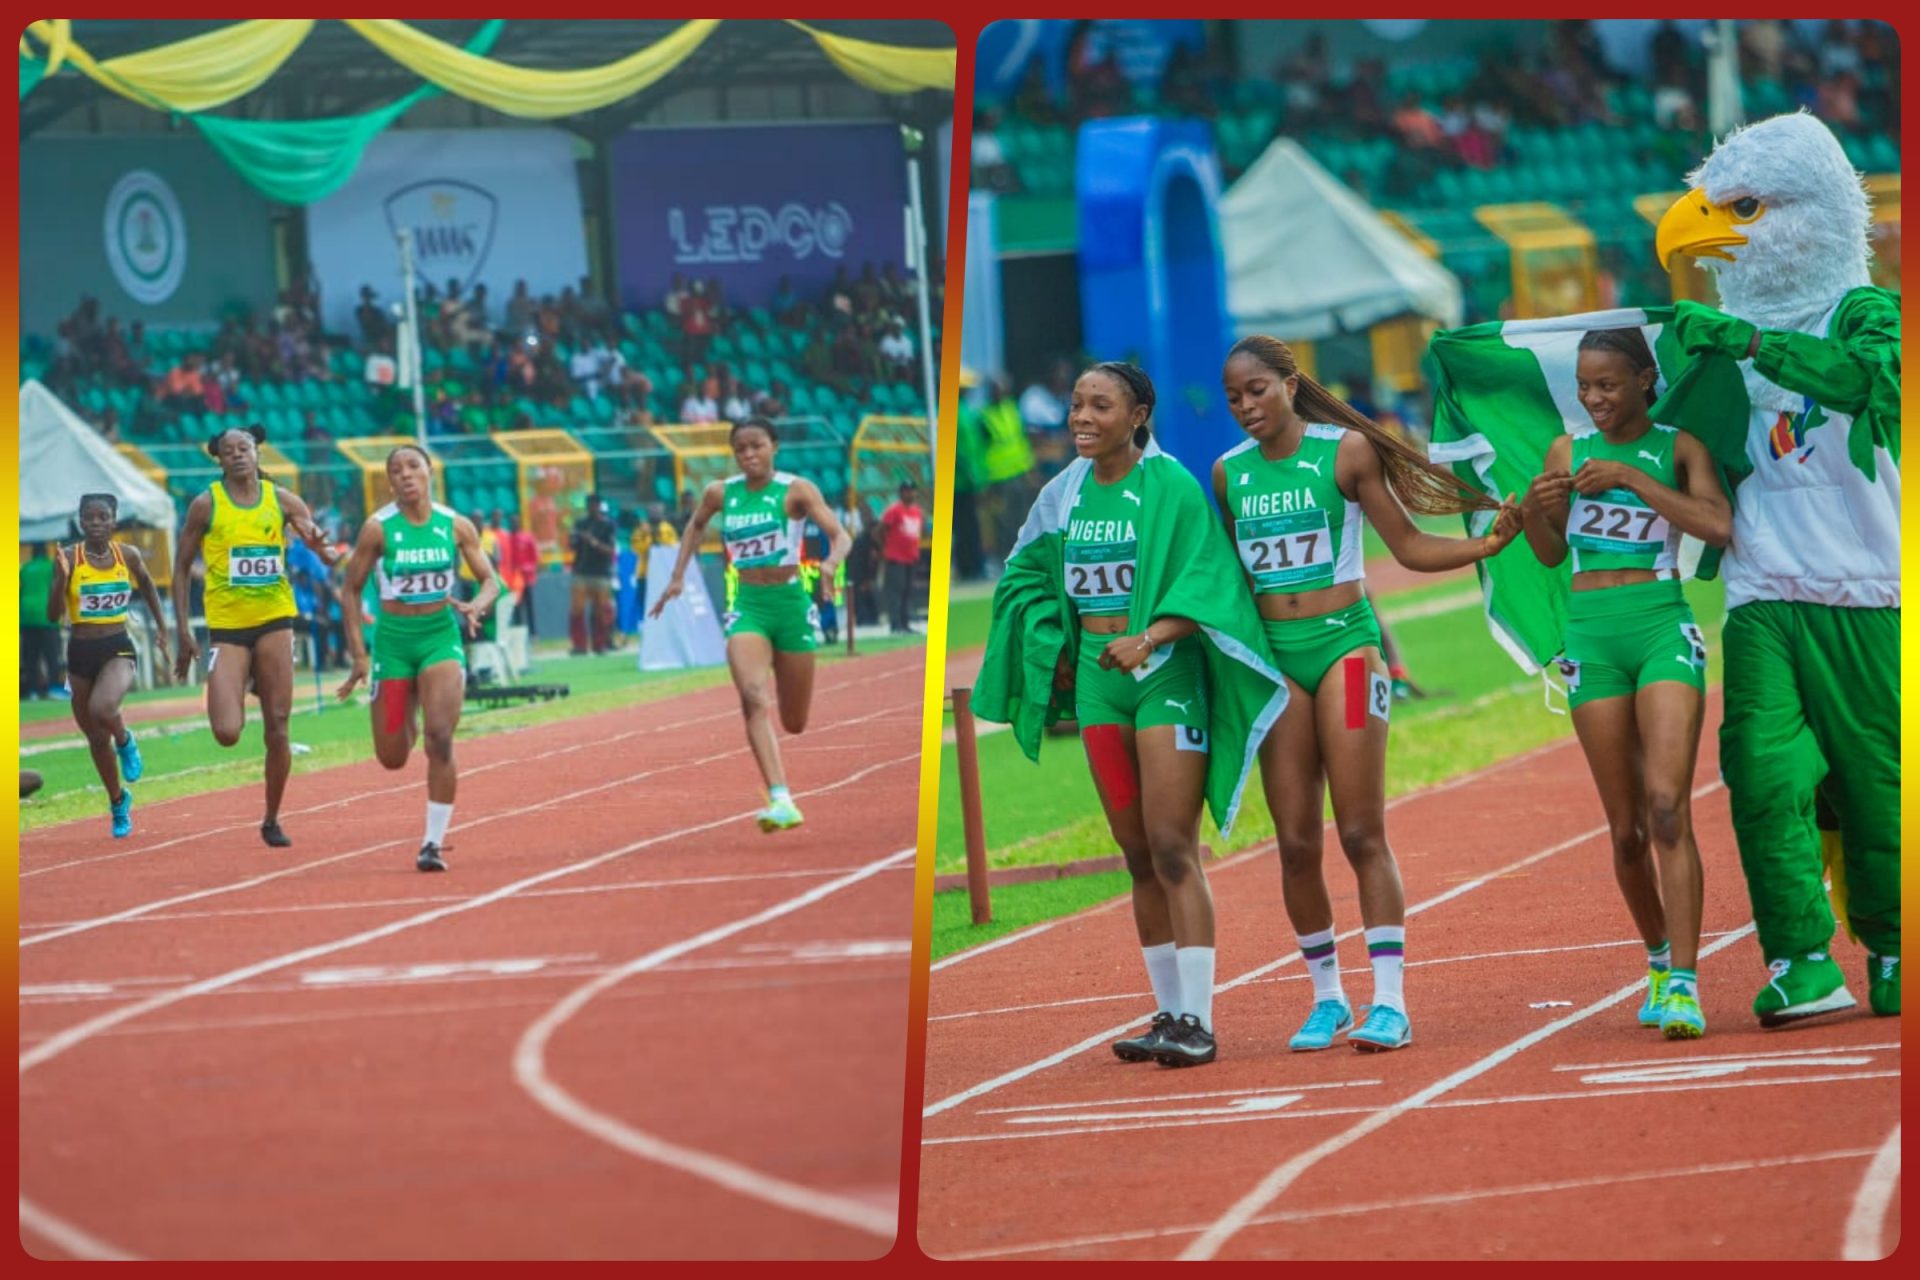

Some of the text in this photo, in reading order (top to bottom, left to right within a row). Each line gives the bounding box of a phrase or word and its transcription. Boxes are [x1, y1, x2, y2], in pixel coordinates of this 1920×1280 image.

[1242, 487, 1317, 518] NIGERIA
[1067, 519, 1137, 542] NIGERIA
[1580, 504, 1659, 541] 227
[396, 548, 450, 563] NIGERIA
[735, 533, 778, 558] 227
[1249, 533, 1319, 571] 217
[237, 558, 278, 576] 061
[400, 573, 448, 594] 210
[1070, 563, 1135, 596] 210
[86, 593, 126, 610] 320
